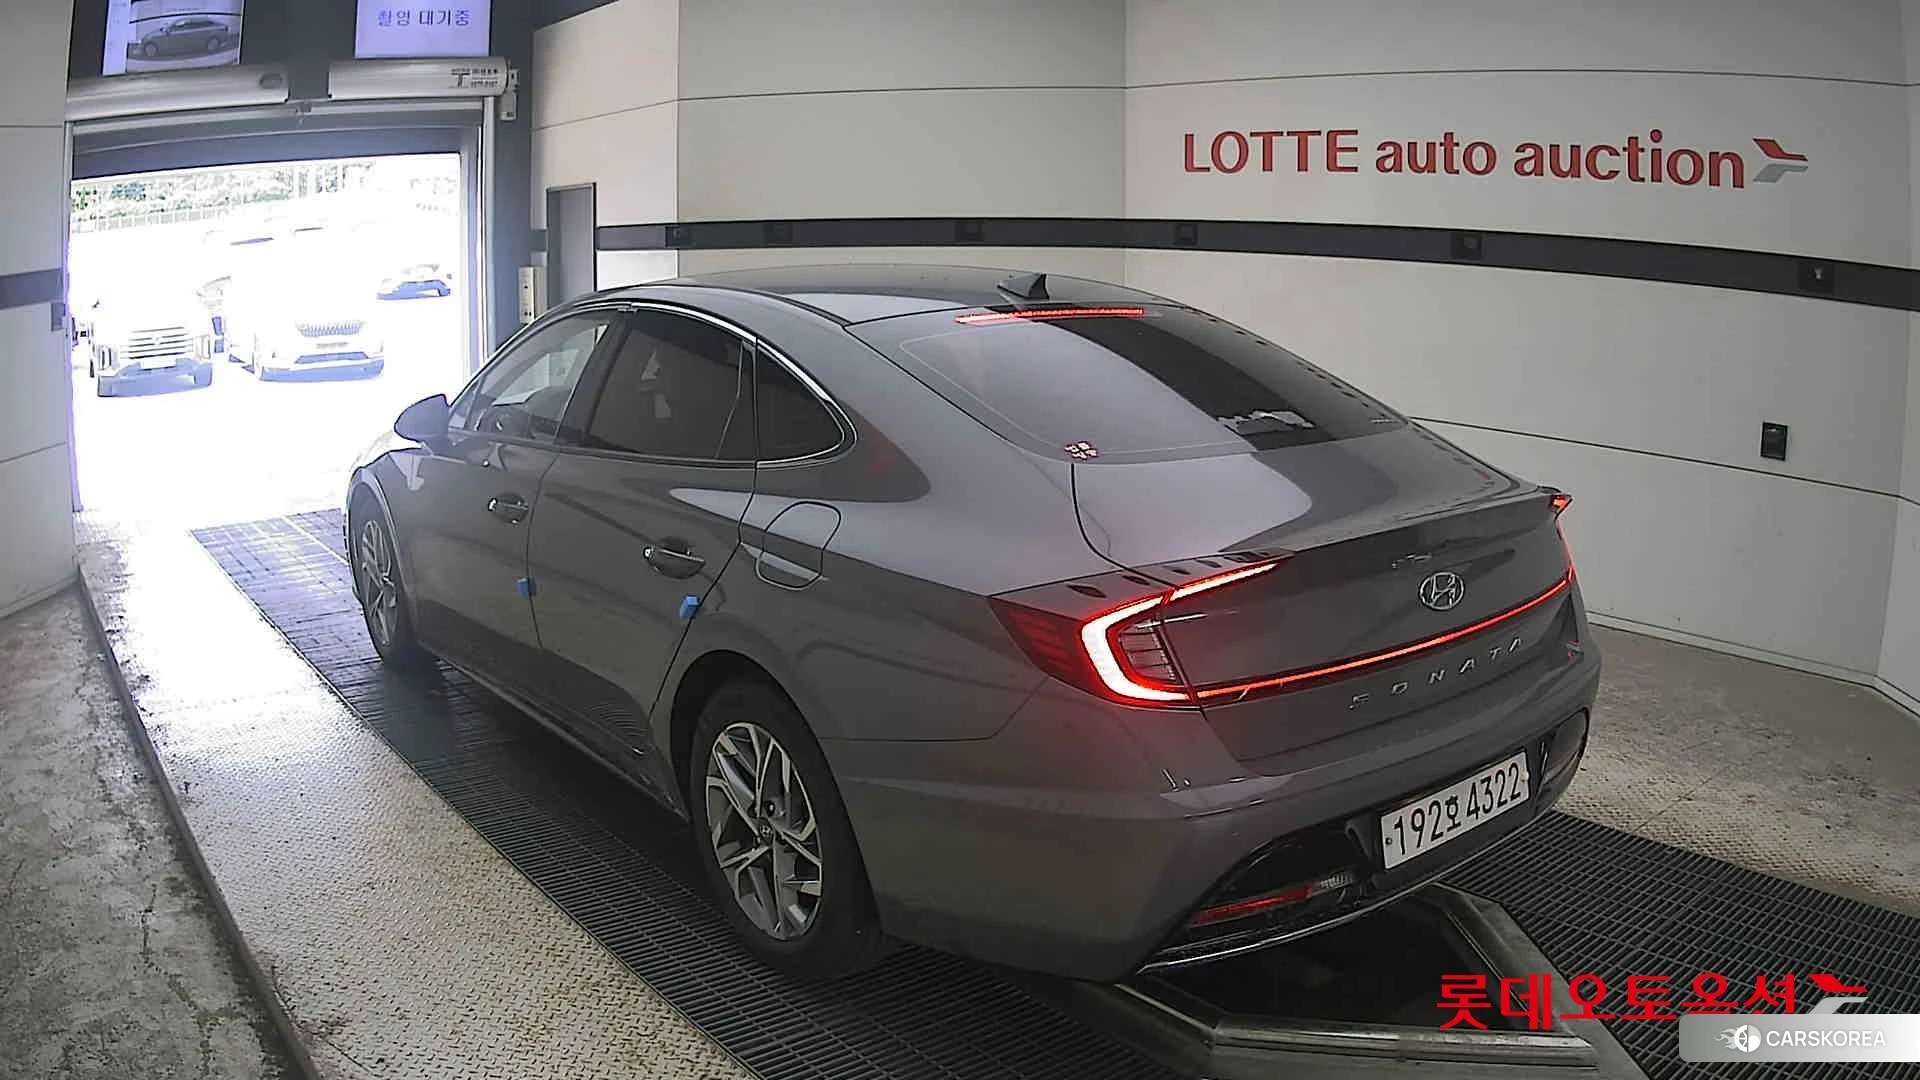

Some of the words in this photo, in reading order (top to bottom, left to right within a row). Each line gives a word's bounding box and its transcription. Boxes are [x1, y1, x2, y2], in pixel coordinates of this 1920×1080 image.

[419, 9, 470, 26] 대기중
[1184, 129, 1359, 173] LOTTE
[1376, 131, 1497, 176] auto
[1514, 129, 1745, 188] auction
[1349, 637, 1522, 710] SONATA
[1394, 794, 1462, 856] 192호
[1466, 762, 1522, 821] 4322
